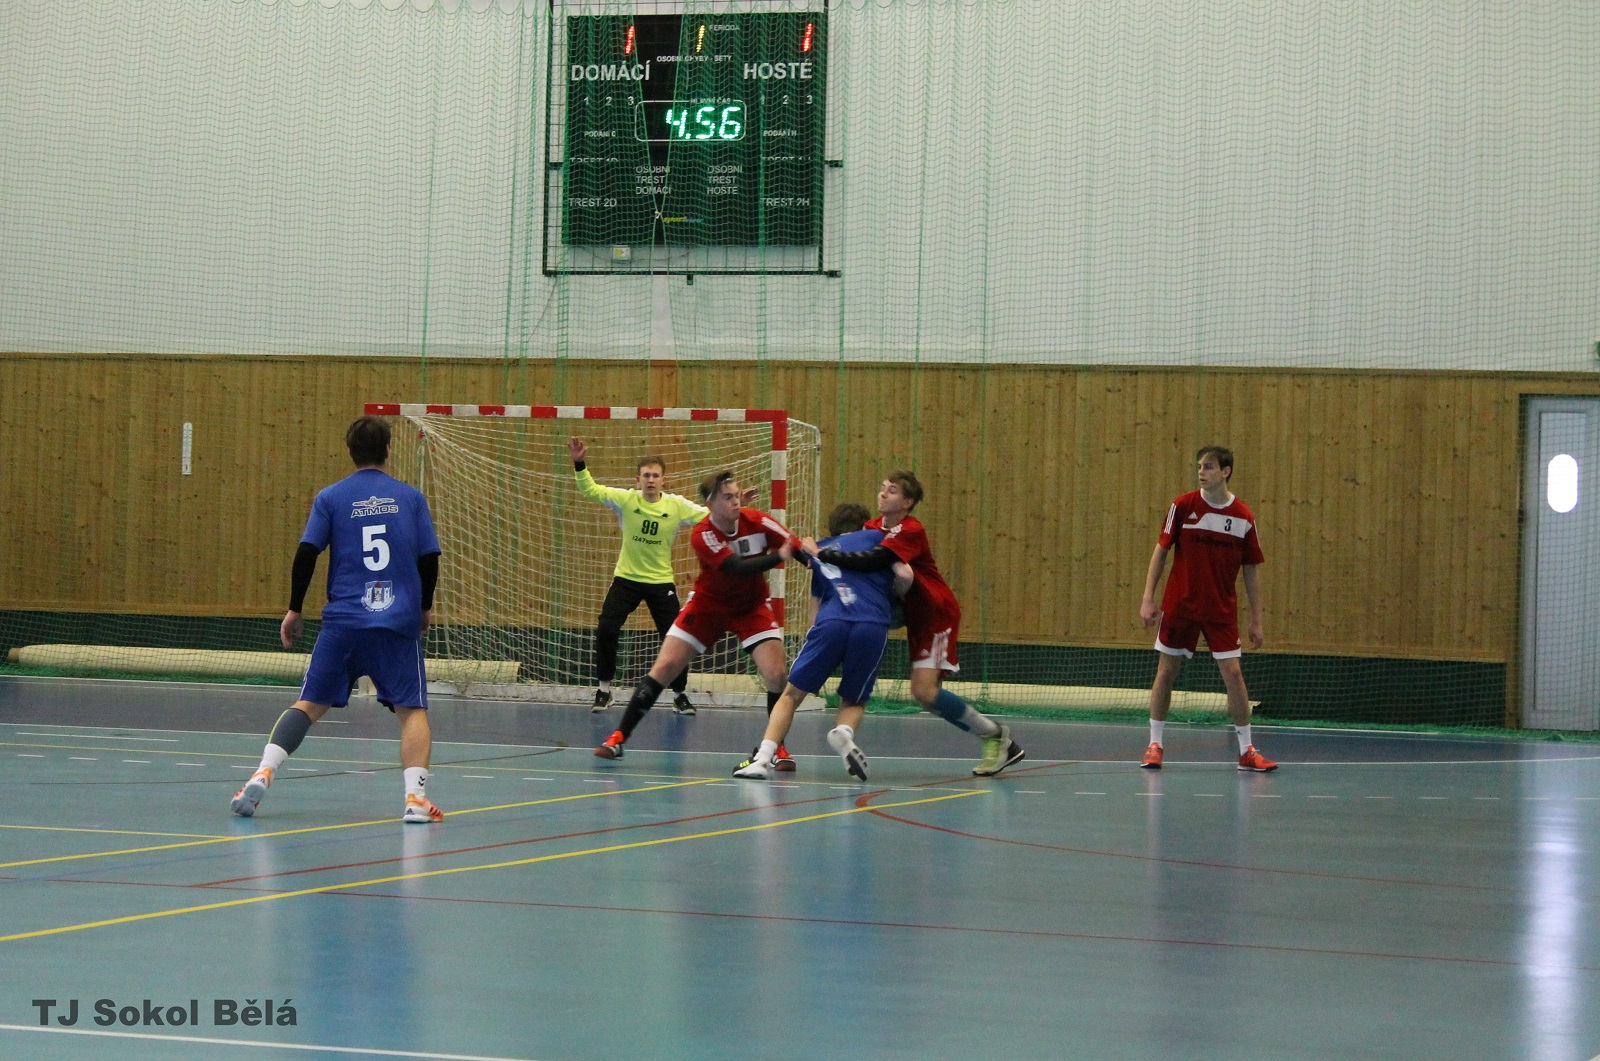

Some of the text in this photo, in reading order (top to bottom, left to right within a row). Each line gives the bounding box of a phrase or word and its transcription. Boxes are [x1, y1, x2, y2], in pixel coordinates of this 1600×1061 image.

[571, 60, 651, 81] DOMÁCÍ
[743, 59, 812, 80] HOSTÉ
[635, 175, 665, 184] TREST
[707, 175, 737, 184] TREST
[569, 198, 618, 207] TREST 2D
[760, 197, 794, 206] TREST
[350, 504, 399, 519] ATMOS
[641, 519, 659, 536] 99
[1224, 518, 1233, 532] 3
[362, 524, 391, 572] 5
